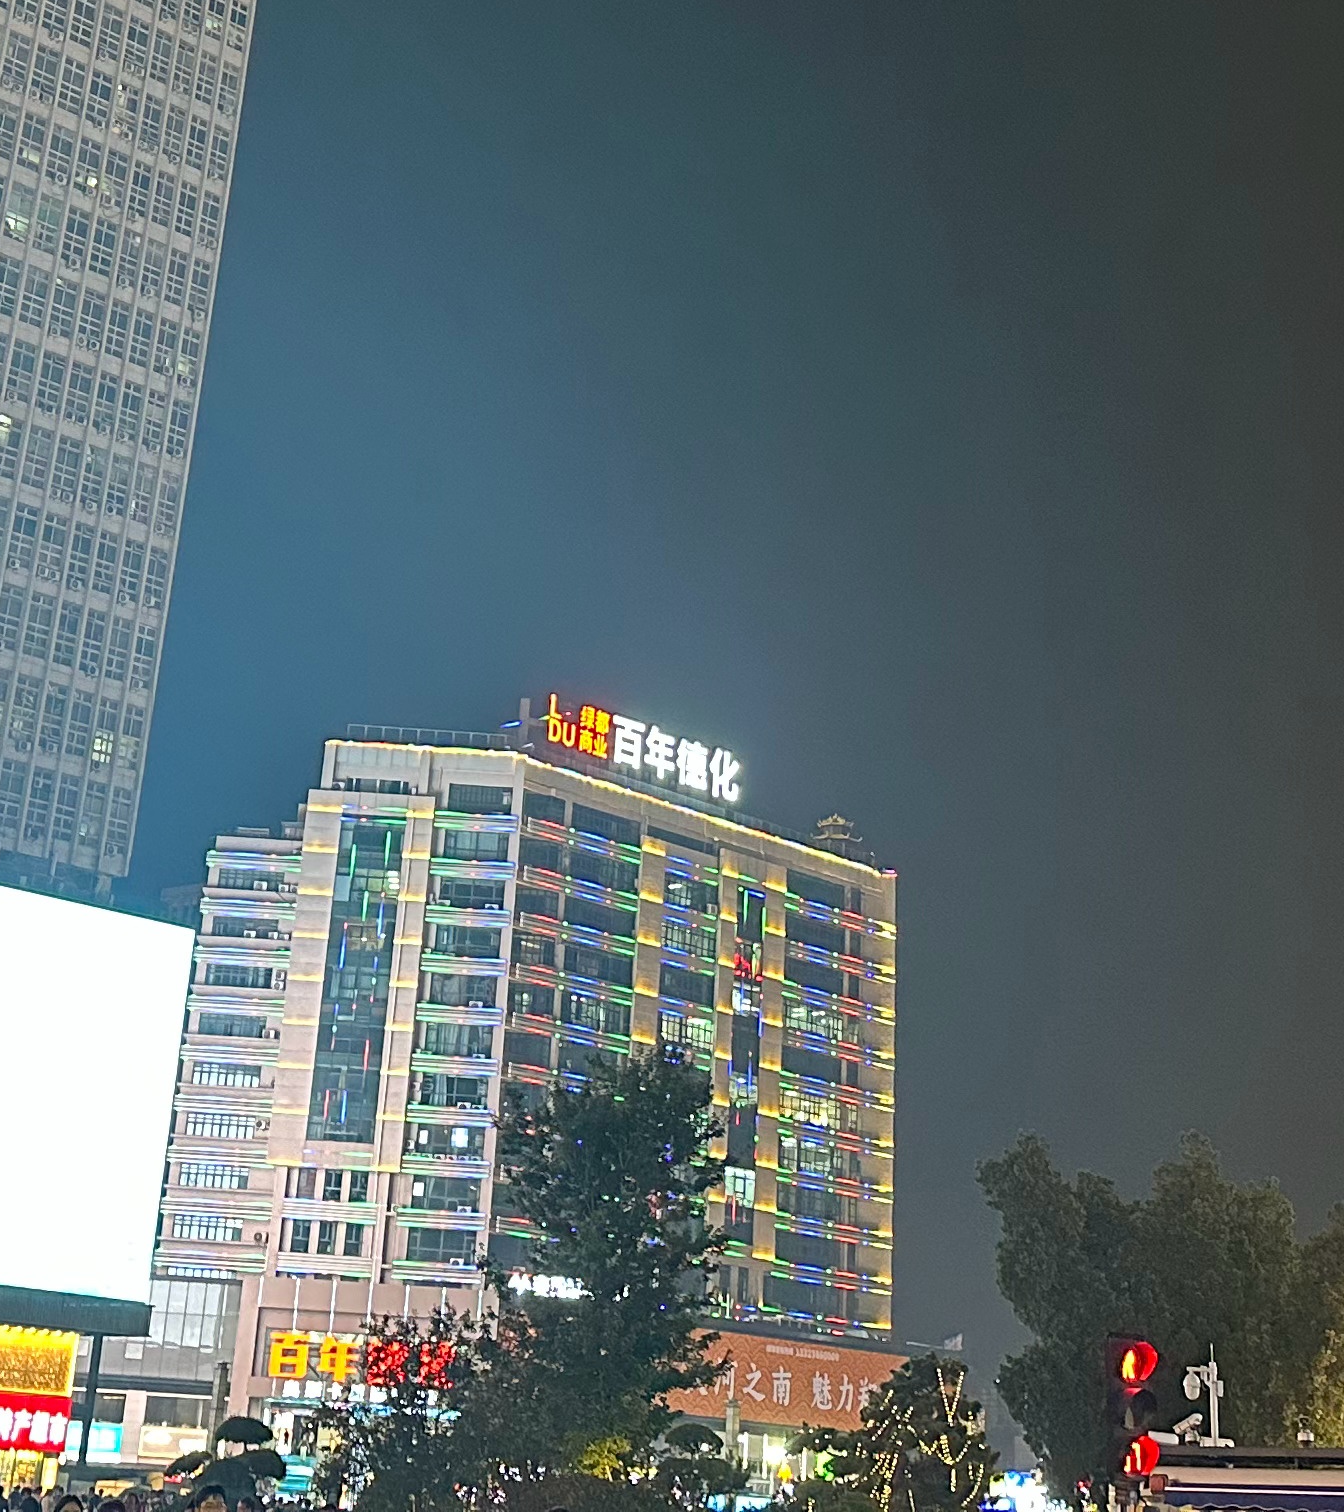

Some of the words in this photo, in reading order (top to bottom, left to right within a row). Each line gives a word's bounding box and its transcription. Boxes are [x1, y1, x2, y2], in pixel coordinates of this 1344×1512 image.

[548, 718, 576, 748] DU
[580, 705, 610, 734] 绿都
[578, 729, 608, 759] 商业
[612, 714, 740, 802] 百年德化
[688, 1361, 792, 1407] 河之南
